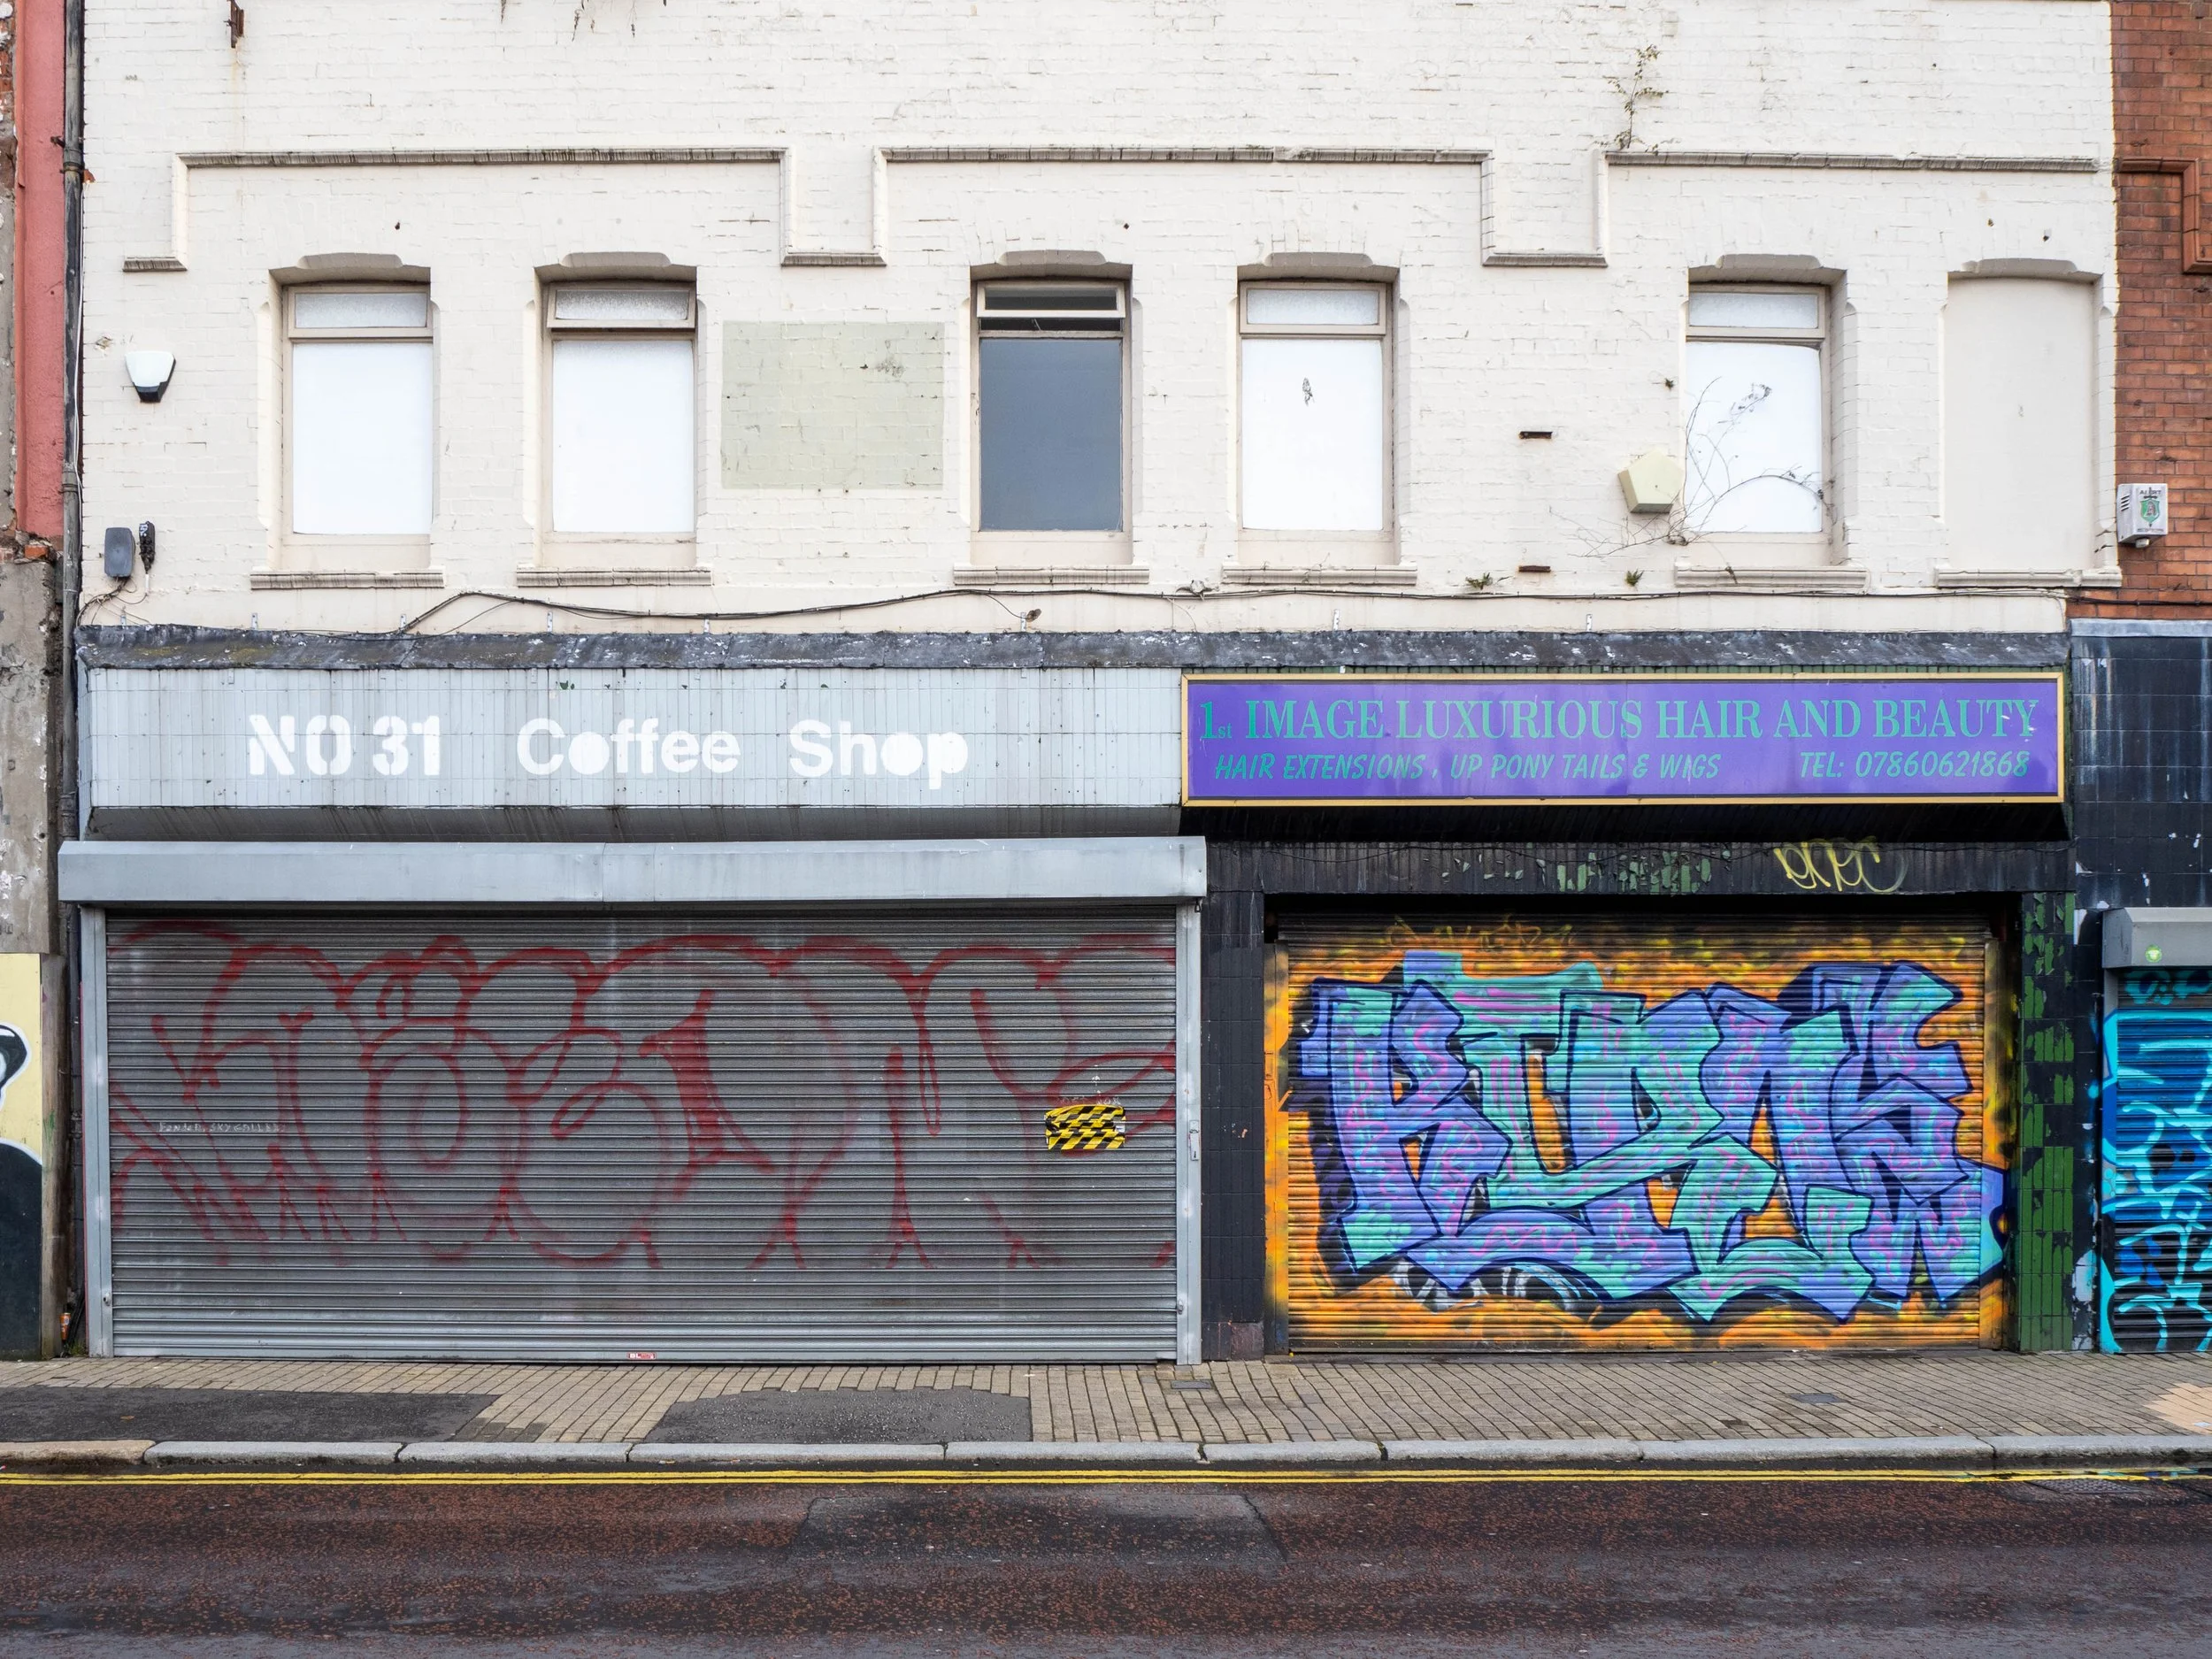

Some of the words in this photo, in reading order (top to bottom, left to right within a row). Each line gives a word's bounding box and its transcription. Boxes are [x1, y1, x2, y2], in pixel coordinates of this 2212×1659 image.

[1201, 701, 1233, 740] 1st
[1246, 699, 1384, 740] IMAGE
[1396, 699, 1643, 740] LUXURIOUS
[1656, 699, 1763, 739] HAIR
[1774, 699, 1862, 738] AND
[1873, 699, 2039, 738] BEAUTY
[250, 714, 352, 776] NO
[373, 715, 441, 776] 31
[517, 717, 741, 776] Coffee
[789, 718, 969, 790] Shop
[1215, 753, 1276, 780] HAIR
[1450, 753, 1483, 780] UP
[1491, 753, 1555, 780] PONY
[1563, 753, 1626, 780] TAILS
[1632, 753, 1650, 779] &
[1660, 753, 1722, 779] WIGS
[1801, 751, 1845, 779] TEL:
[1855, 749, 2030, 778] 07860621868
